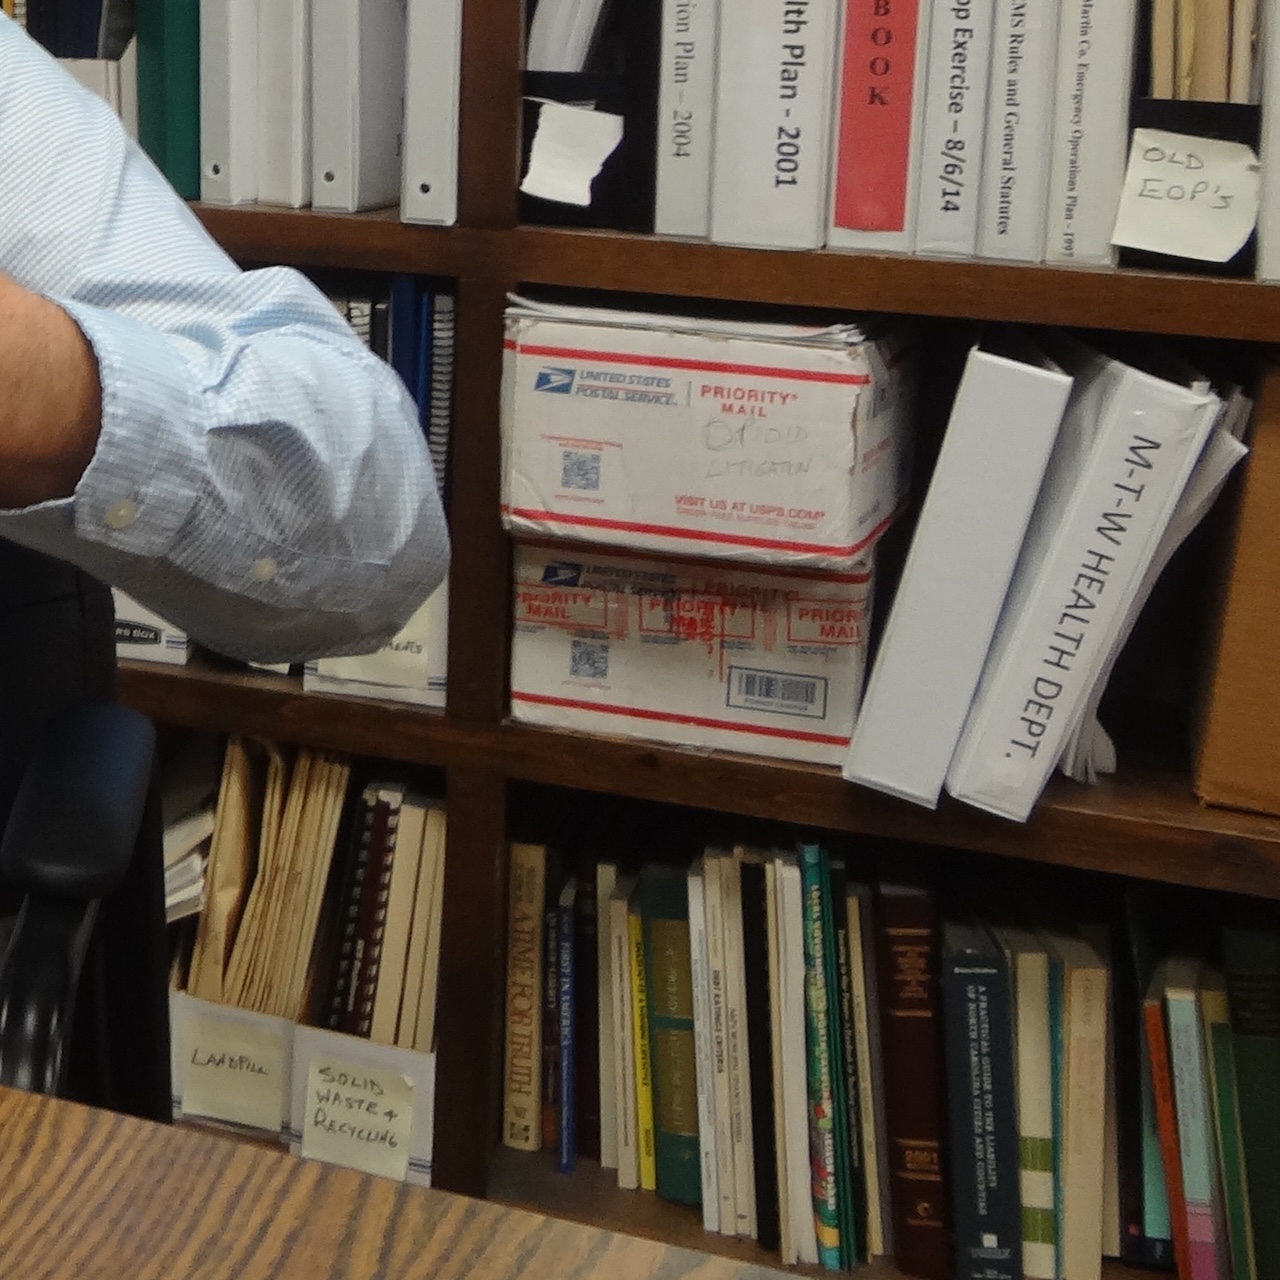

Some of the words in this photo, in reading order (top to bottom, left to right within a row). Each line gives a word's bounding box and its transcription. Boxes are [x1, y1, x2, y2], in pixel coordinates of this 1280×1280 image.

[674, 41, 695, 84] Plan
[779, 44, 806, 100] Plan
[948, 28, 974, 114] Exercise
[1008, 33, 1025, 74] Rules
[1005, 79, 1020, 107] and
[1072, 63, 1090, 127] Emergency
[672, 110, 693, 158] 2004
[1002, 111, 1020, 171] General
[774, 126, 801, 188] 2001
[938, 139, 966, 212] 8/6/14
[1067, 129, 1083, 191] Operations
[1142, 147, 1205, 170] OLD
[997, 175, 1016, 235] Statutes
[1063, 195, 1078, 220] Plan
[575, 387, 620, 401] POSTAL
[579, 369, 628, 384] UNITED
[628, 374, 672, 389] STATES
[721, 403, 768, 418] MAIL
[675, 494, 706, 507] VISIT
[710, 499, 727, 510] US
[732, 502, 746, 512] AT
[1096, 435, 1162, 546] M-T-W
[1043, 548, 1116, 671] HEALTH
[1005, 675, 1063, 759] DEPT.
[510, 981, 536, 1026] FOR
[967, 984, 976, 999] OF
[978, 984, 987, 992] A
[968, 1002, 978, 1039] NORTH
[979, 995, 990, 1053] PRACTICAL
[318, 1067, 384, 1096] SOLID
[509, 1028, 534, 1096] TRUTH
[969, 1041, 981, 1095] CAROLINA
[981, 1056, 992, 1090] GUIDE
[316, 1089, 378, 1115] WASTE
[972, 1098, 983, 1134] CITIES
[984, 1093, 993, 1108] TO
[985, 1111, 994, 1131] THE
[975, 1136, 984, 1159] AND
[976, 1161, 988, 1215] COUNTIES
